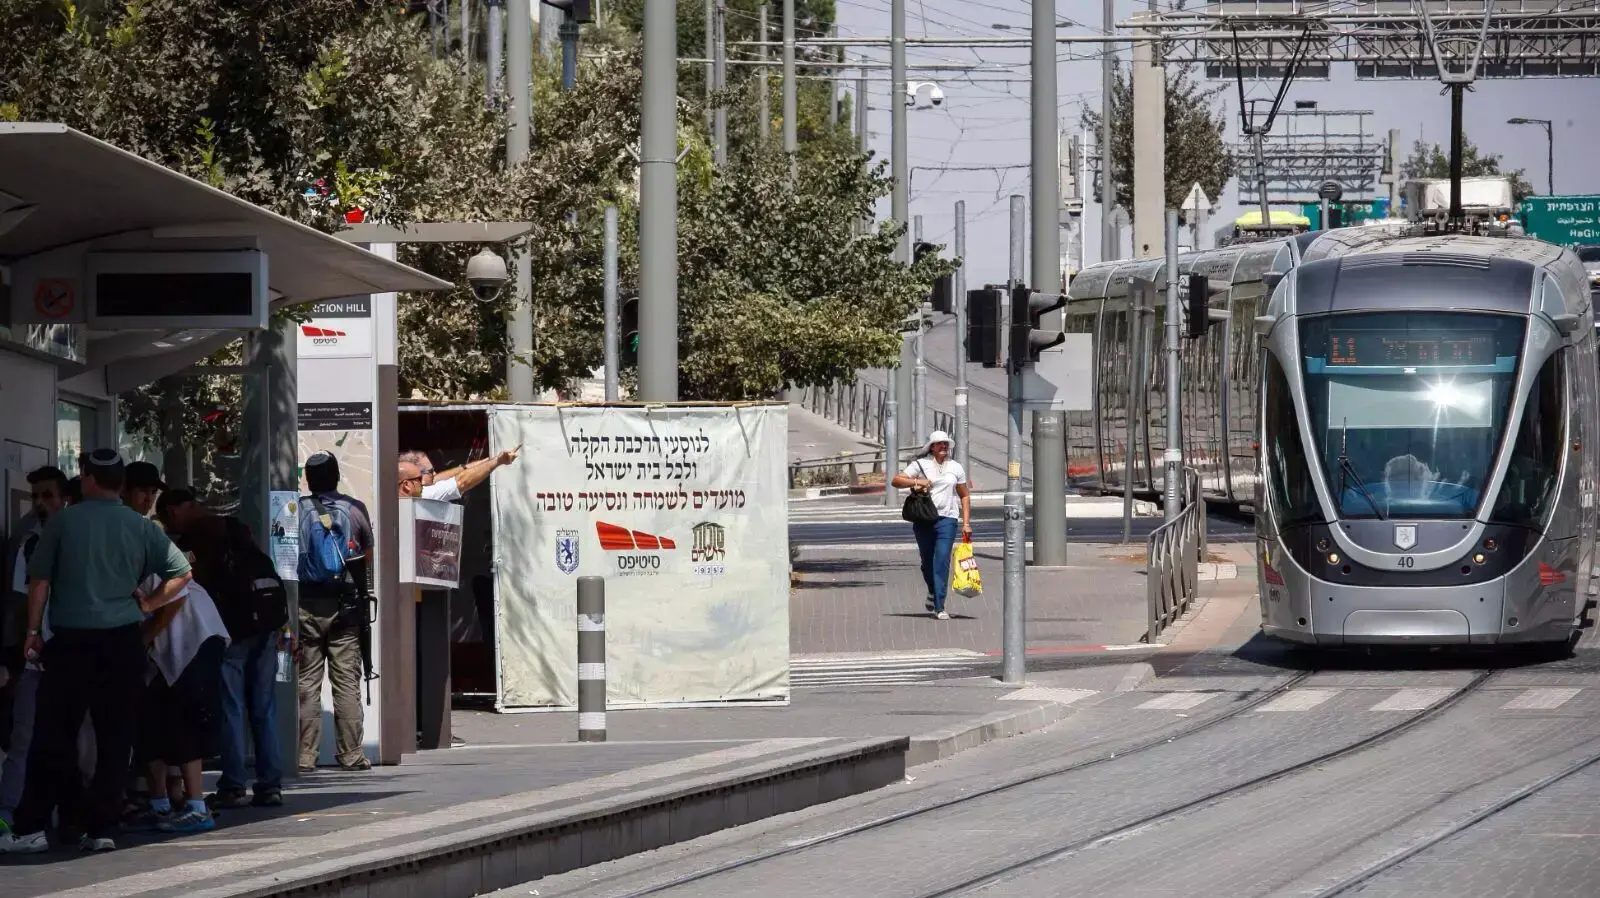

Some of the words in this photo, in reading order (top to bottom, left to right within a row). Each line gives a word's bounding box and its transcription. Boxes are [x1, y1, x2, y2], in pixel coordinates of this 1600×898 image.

[1547, 202, 1594, 212] הצרפתית
[346, 303, 367, 313] HILL
[571, 428, 610, 459] הקלה
[614, 436, 661, 455] הרכבת
[664, 428, 710, 454] לנוסעי
[585, 454, 632, 481] ישראל
[636, 462, 660, 480] בית
[665, 454, 697, 480] ולכל
[536, 492, 574, 512] טובה
[578, 491, 628, 512] ונסיעה
[633, 482, 688, 510] לשמחה
[693, 489, 746, 510] מועדים
[617, 555, 661, 569] סיטיפס
[1397, 556, 1415, 568] 40
